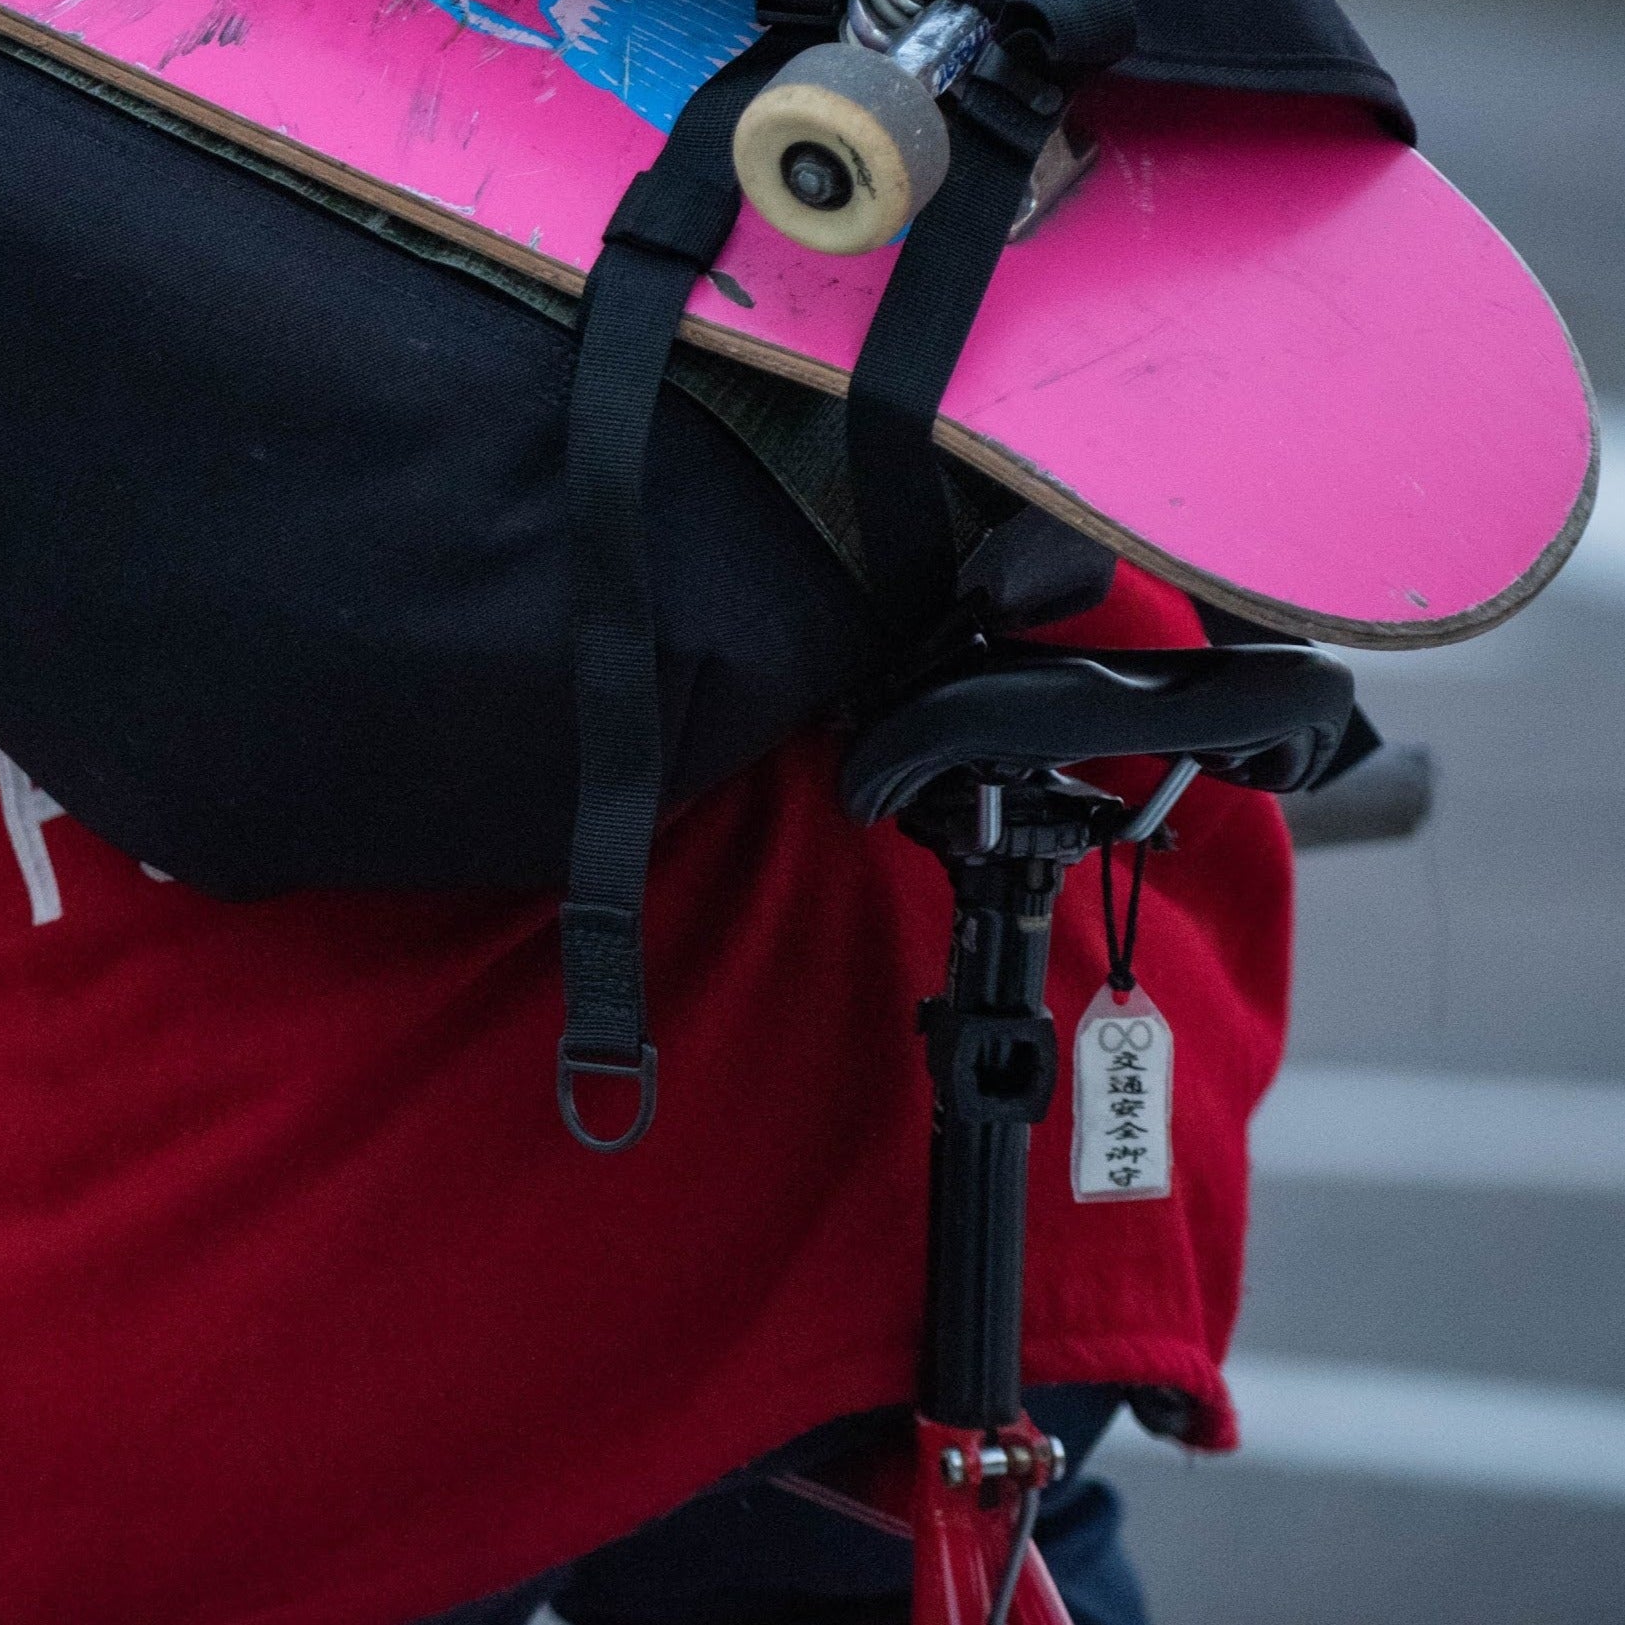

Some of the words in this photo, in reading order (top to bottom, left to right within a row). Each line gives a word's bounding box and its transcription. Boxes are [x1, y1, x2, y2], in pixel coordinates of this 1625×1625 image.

[1105, 1051, 1148, 1187] 交通安全御守
